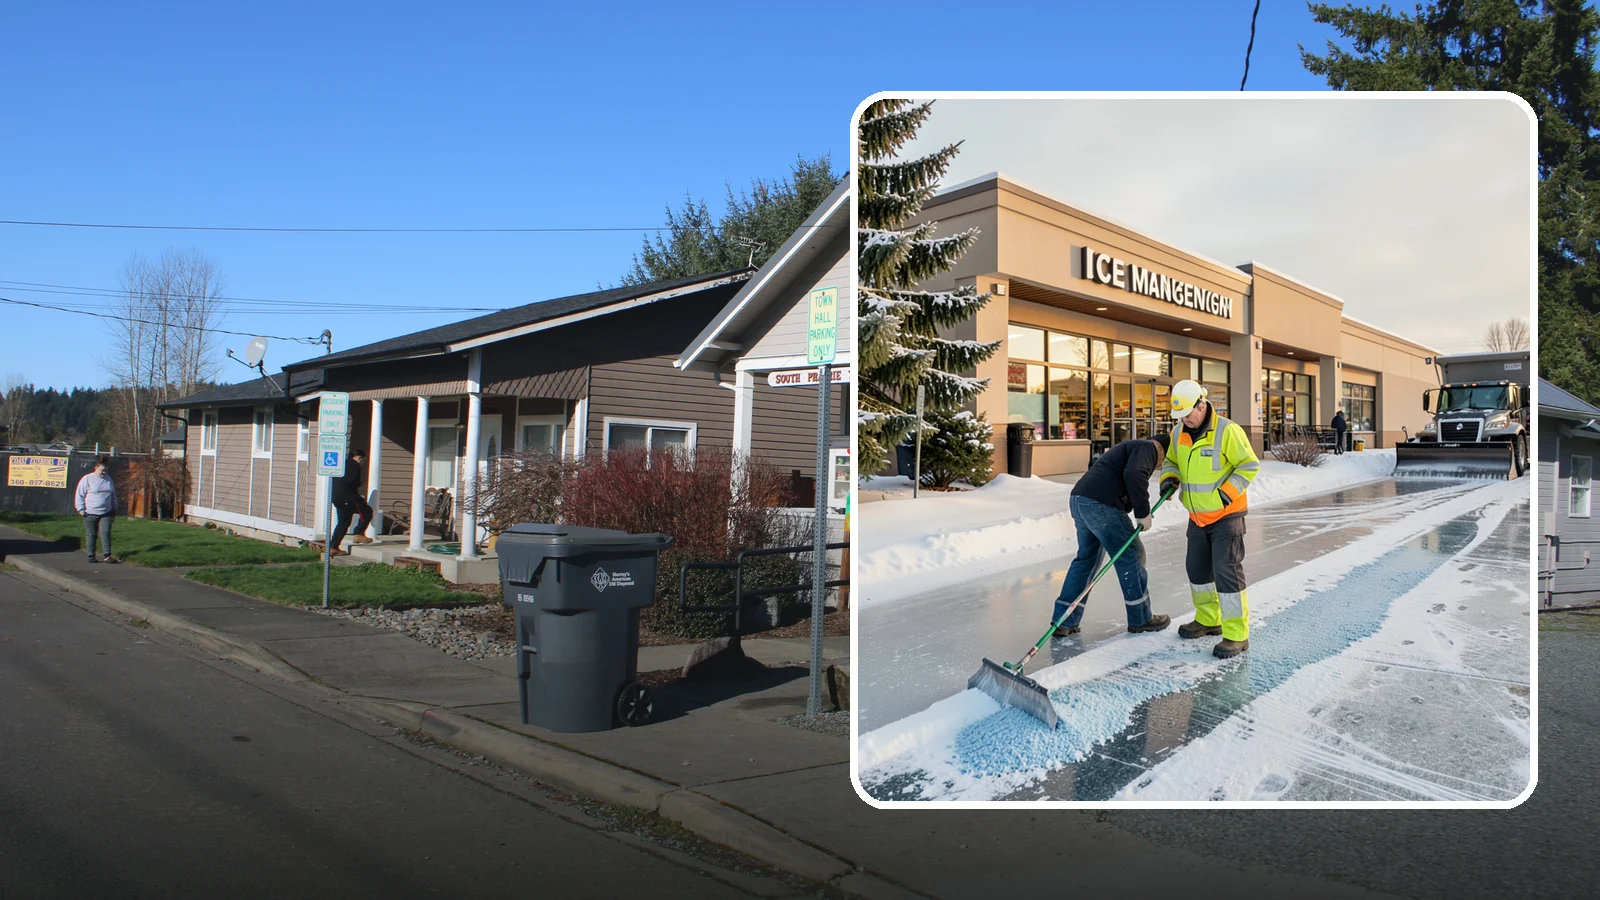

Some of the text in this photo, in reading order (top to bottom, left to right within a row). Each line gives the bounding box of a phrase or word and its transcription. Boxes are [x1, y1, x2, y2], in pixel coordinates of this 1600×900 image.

[1082, 246, 1125, 289] ICE
[815, 295, 833, 308] TOWN
[814, 312, 831, 324] HALL
[810, 326, 836, 340] PARKING
[814, 344, 831, 357] ONLY
[775, 374, 801, 384] SOUTH
